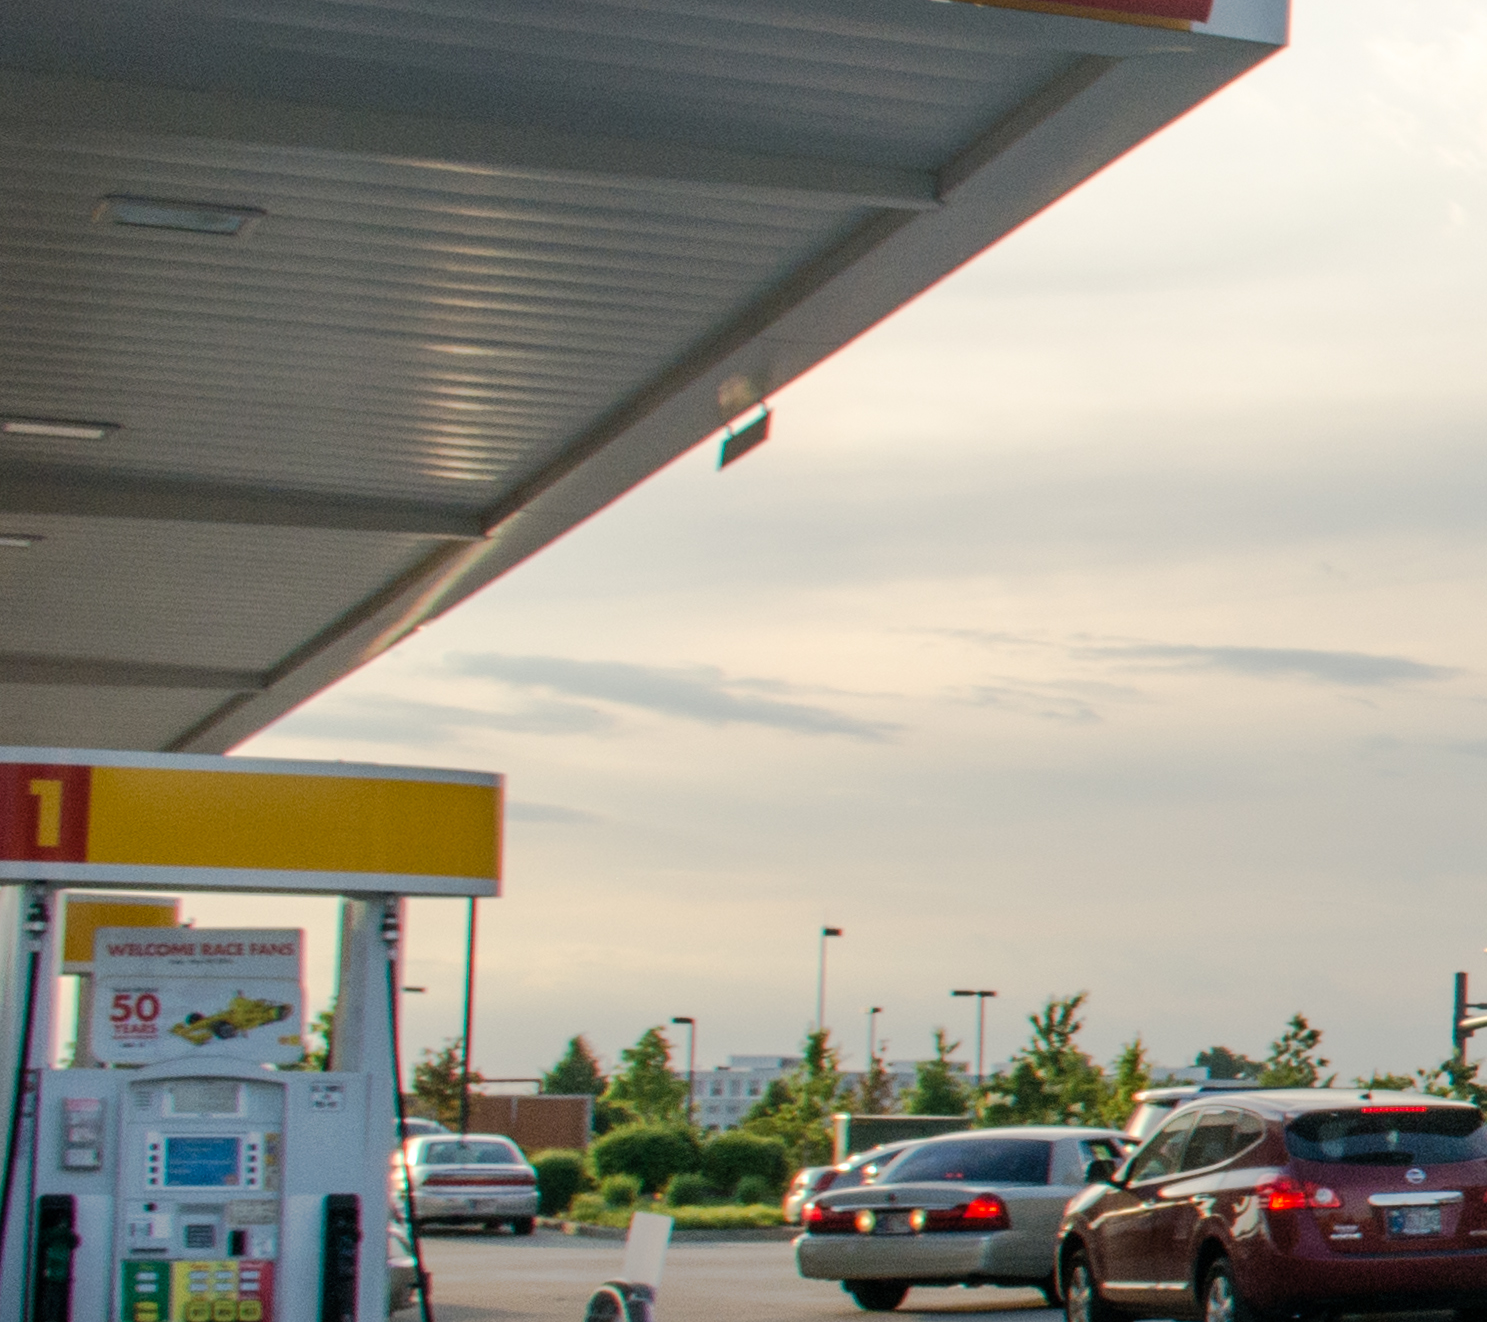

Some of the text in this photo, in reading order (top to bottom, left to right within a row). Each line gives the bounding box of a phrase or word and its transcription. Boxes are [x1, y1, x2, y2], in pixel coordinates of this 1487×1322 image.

[29, 779, 63, 847] 1
[106, 942, 296, 957] WELCOME RACE FANS
[109, 992, 162, 1023] 50
